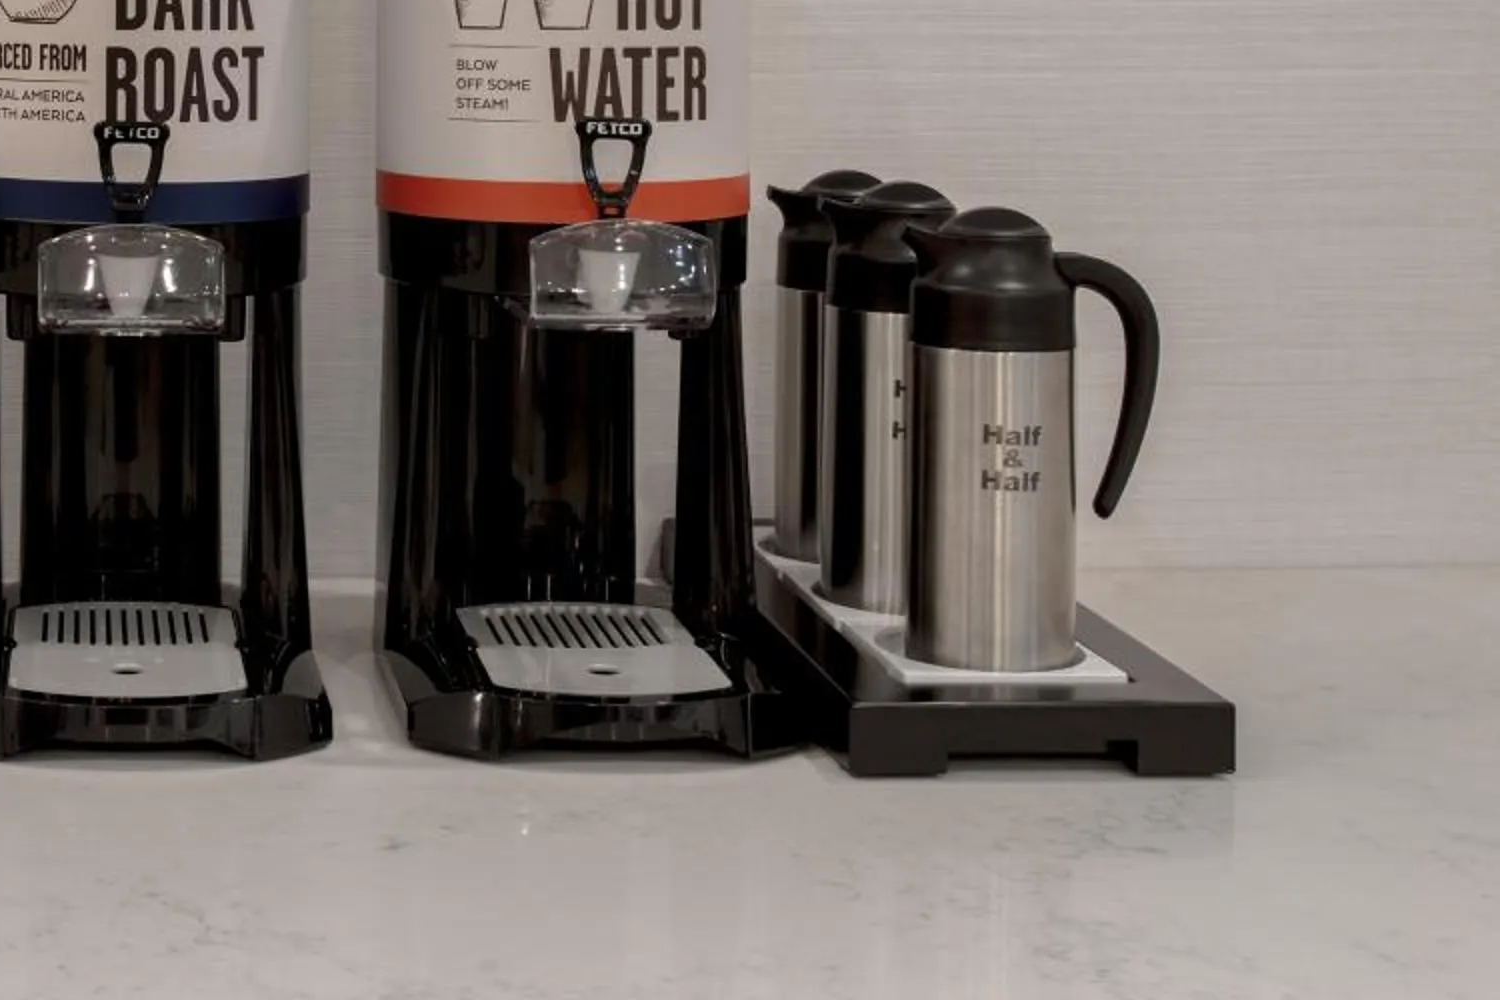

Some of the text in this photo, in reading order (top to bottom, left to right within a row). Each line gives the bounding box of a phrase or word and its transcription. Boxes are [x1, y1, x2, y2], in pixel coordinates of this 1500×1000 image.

[39, 44, 87, 73] FROM
[456, 59, 499, 72] BLOW
[105, 46, 265, 123] ROAST
[456, 77, 532, 92] OFF SOME
[548, 46, 708, 123] WATER
[21, 89, 85, 103] AMERICA
[21, 109, 86, 122] AMERICA
[586, 121, 643, 135] FETCO
[982, 423, 1042, 446] Half
[1003, 449, 1023, 467] &
[981, 469, 1041, 492] Half
